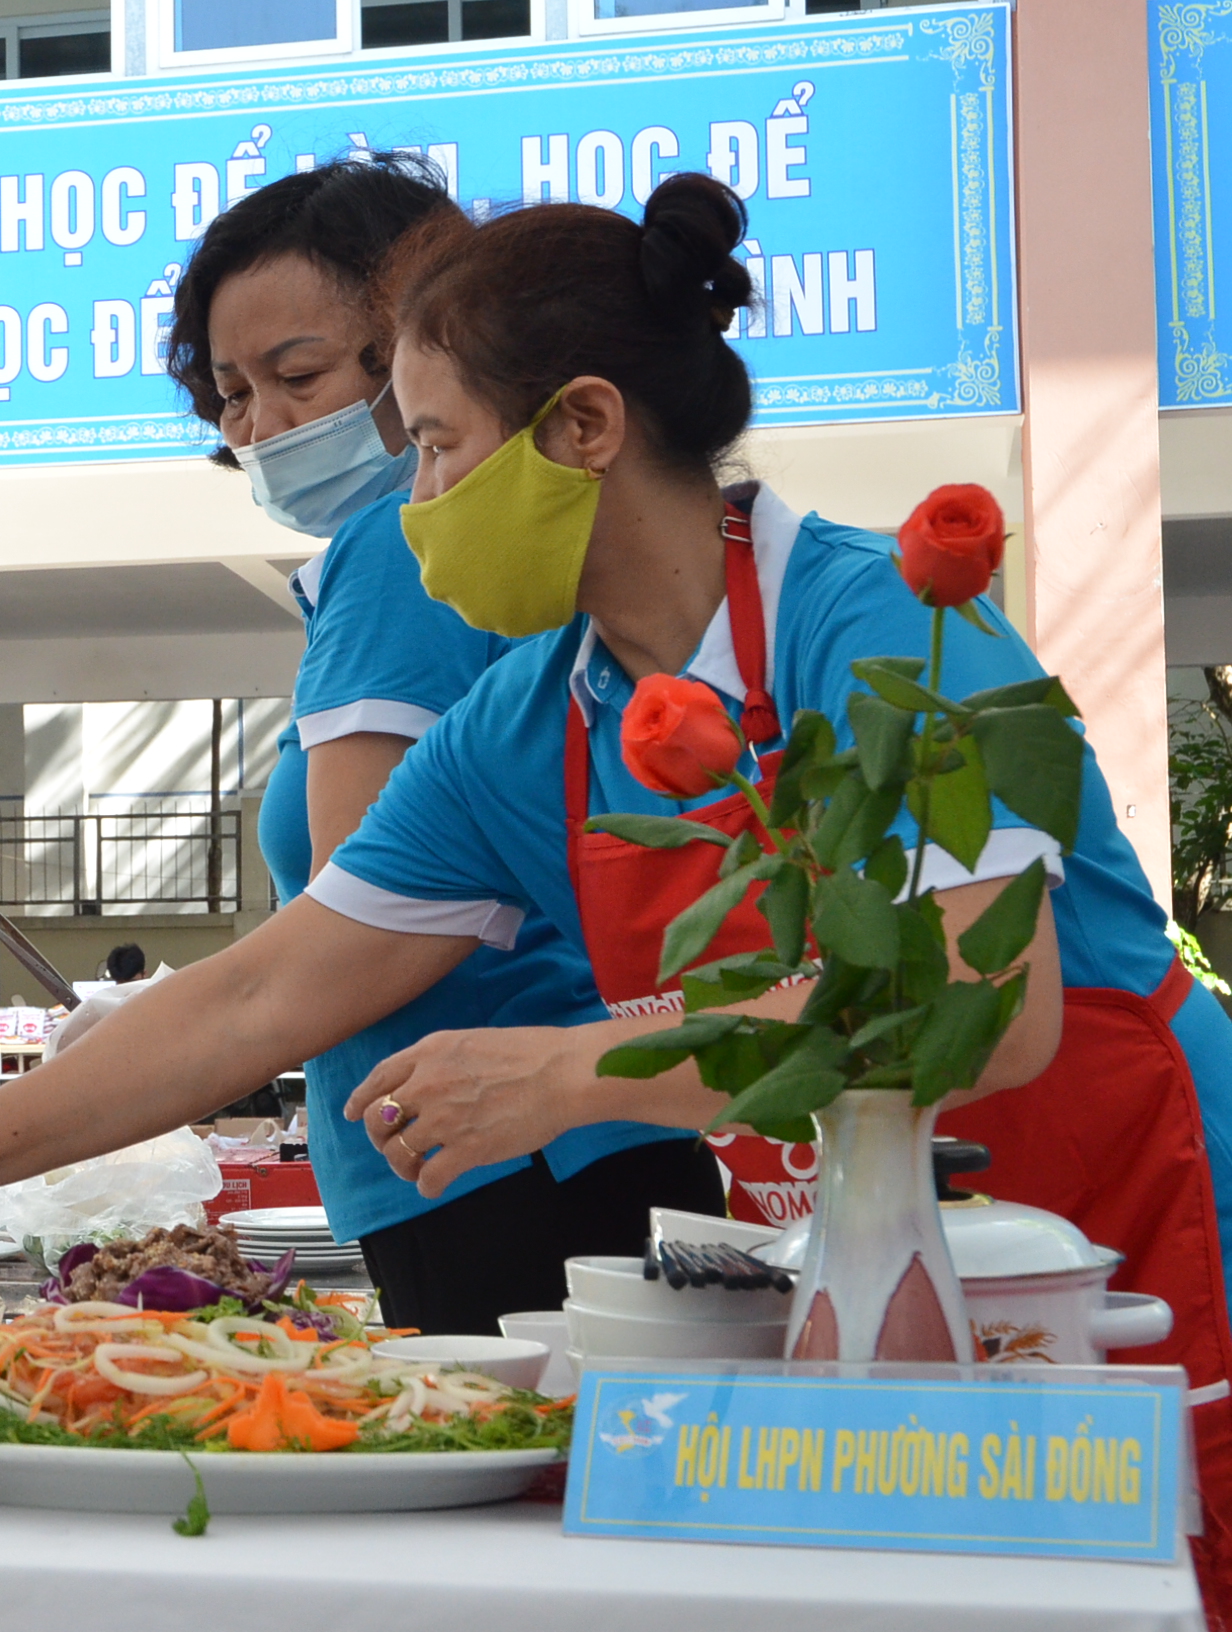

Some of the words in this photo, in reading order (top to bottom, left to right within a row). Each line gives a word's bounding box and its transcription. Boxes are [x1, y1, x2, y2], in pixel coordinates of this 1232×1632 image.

[0, 165, 147, 268] HỌC
[706, 80, 816, 201] ĐỂ
[90, 262, 183, 379] ĐỂ
[722, 238, 878, 340] ÌNH
[674, 1411, 732, 1503] HỘI
[737, 1425, 825, 1493] LHPN
[832, 1413, 969, 1498] PHƯỜNG
[978, 1419, 1037, 1500] SÀI
